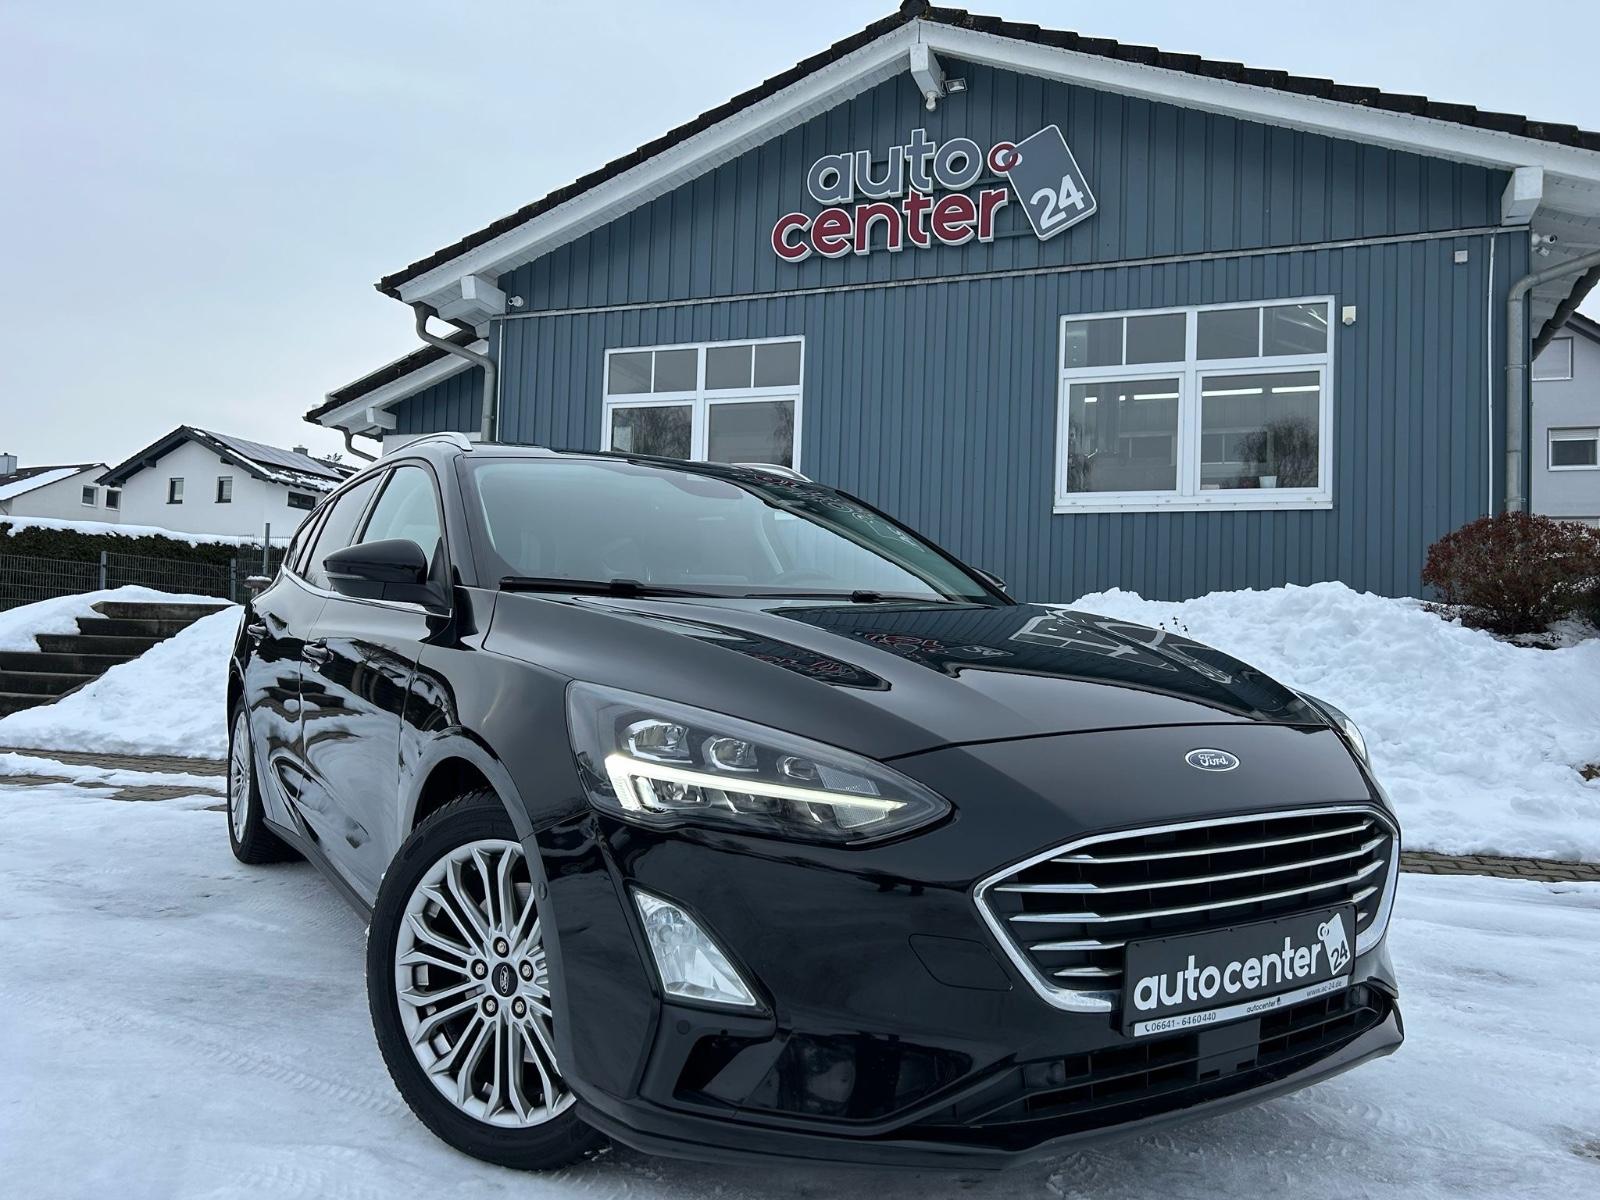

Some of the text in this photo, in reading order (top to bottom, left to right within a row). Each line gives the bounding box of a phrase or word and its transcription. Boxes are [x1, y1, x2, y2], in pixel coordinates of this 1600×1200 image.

[807, 128, 983, 205] auto
[771, 186, 1008, 262] center
[1030, 174, 1084, 230] 24
[1198, 753, 1228, 766] Ford
[1133, 937, 1321, 1011] autocenter
[1330, 940, 1348, 971] 24
